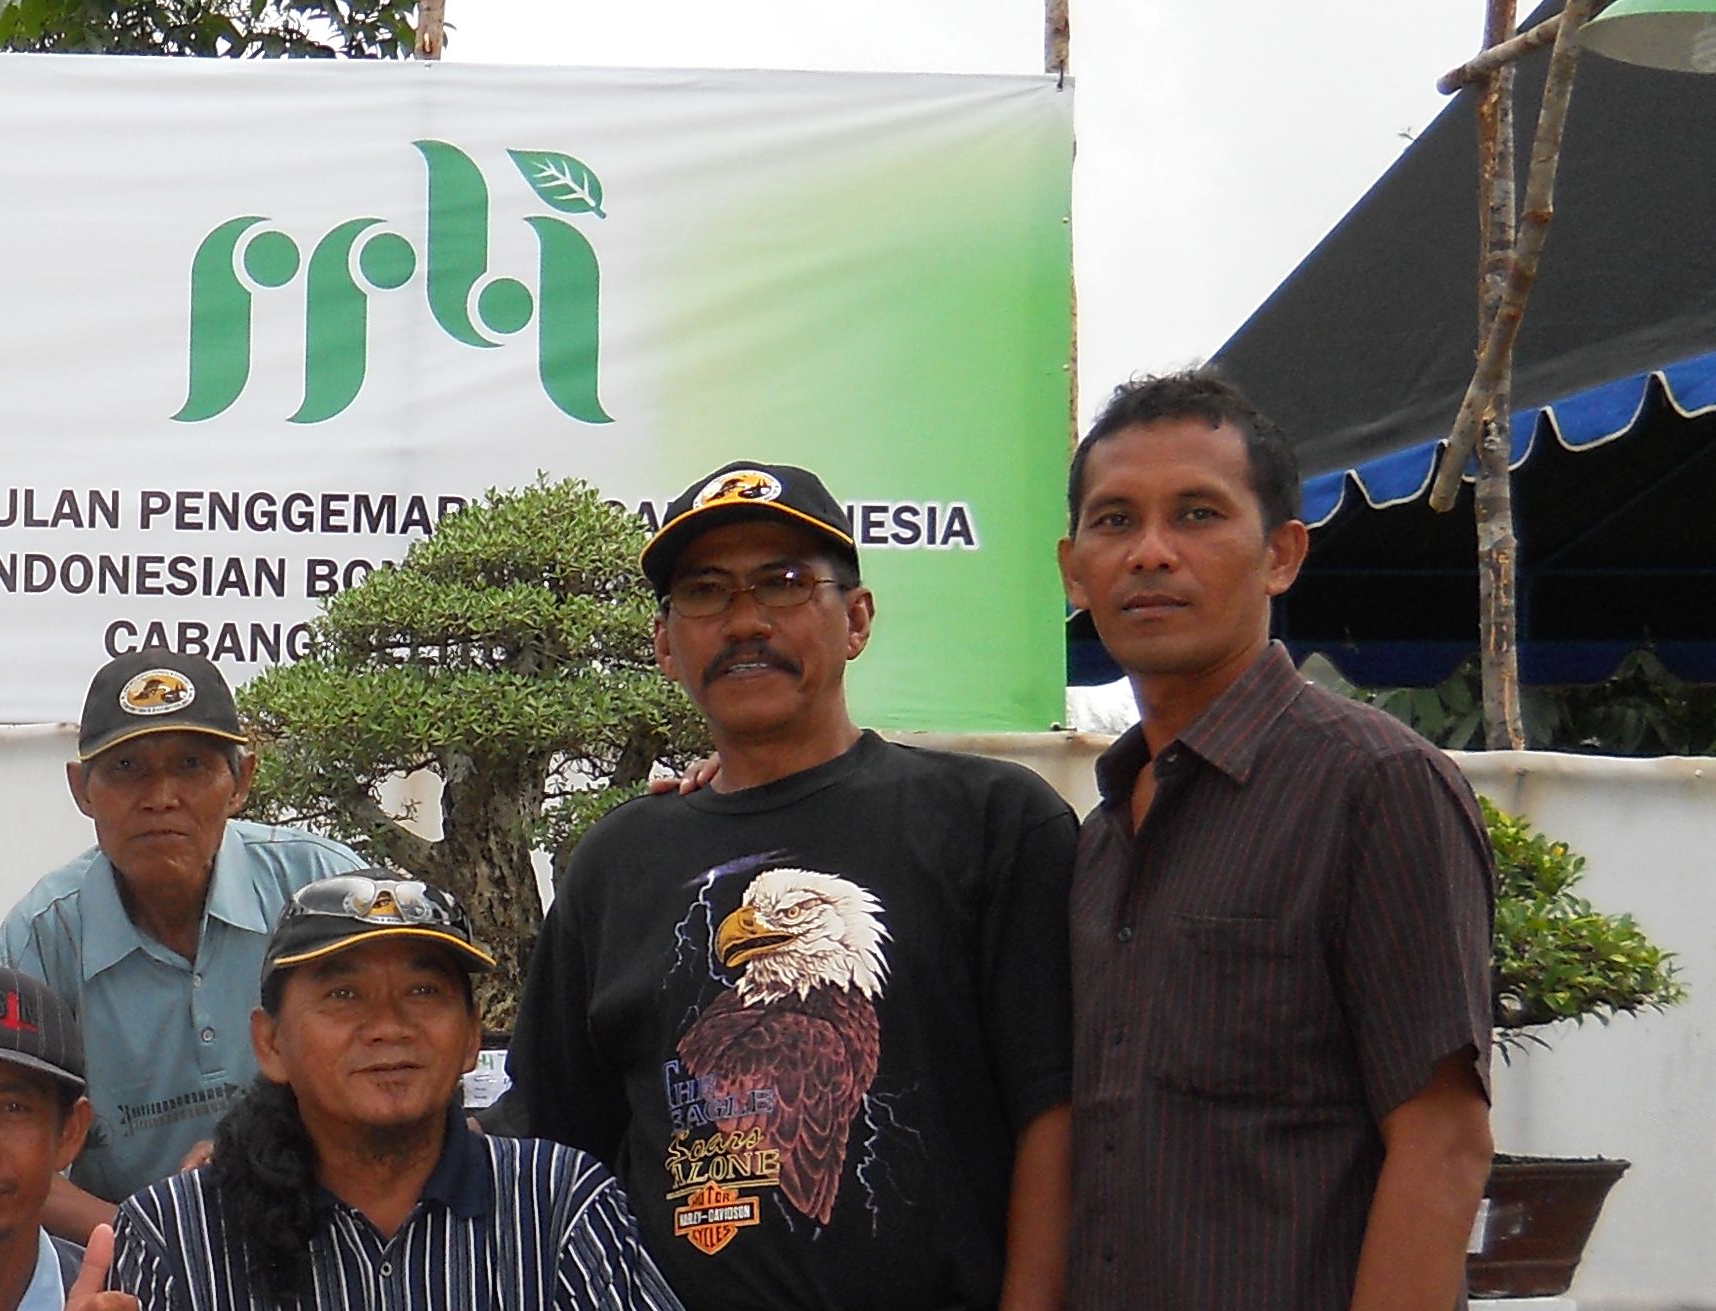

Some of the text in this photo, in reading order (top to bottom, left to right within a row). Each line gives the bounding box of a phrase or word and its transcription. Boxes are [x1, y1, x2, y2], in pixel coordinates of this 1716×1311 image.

[104, 620, 319, 663] CABANG
[670, 1148, 781, 1189] ALONE
[691, 1185, 731, 1208] MOTOR
[679, 1204, 751, 1227] HARLEY-DAVIDSON
[692, 1225, 732, 1249] CYCLES
